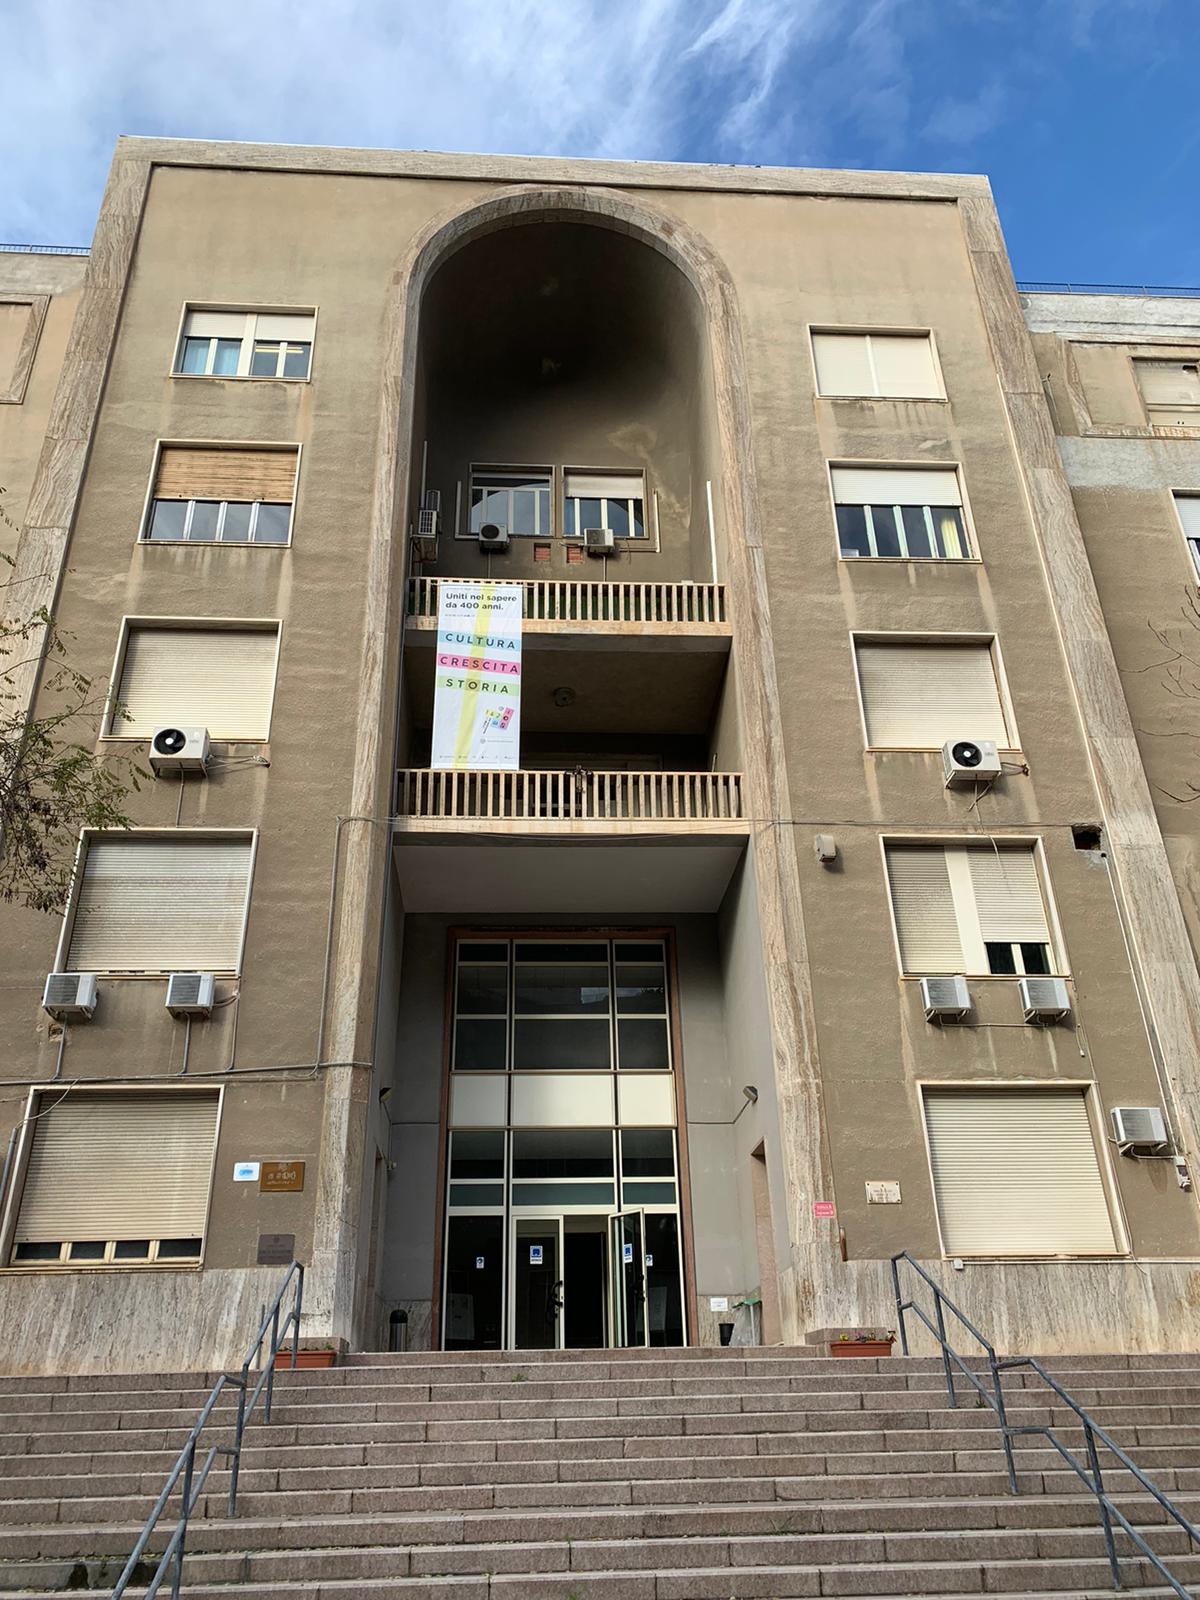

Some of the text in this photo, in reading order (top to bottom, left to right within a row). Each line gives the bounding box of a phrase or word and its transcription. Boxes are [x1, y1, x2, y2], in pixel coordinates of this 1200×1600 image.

[445, 601, 457, 609] da
[446, 592, 468, 600] Uniti
[486, 594, 517, 603] sapere
[445, 633, 515, 649] CULTURA
[440, 656, 518, 673] CRESCITA
[446, 678, 508, 694] STORIA
